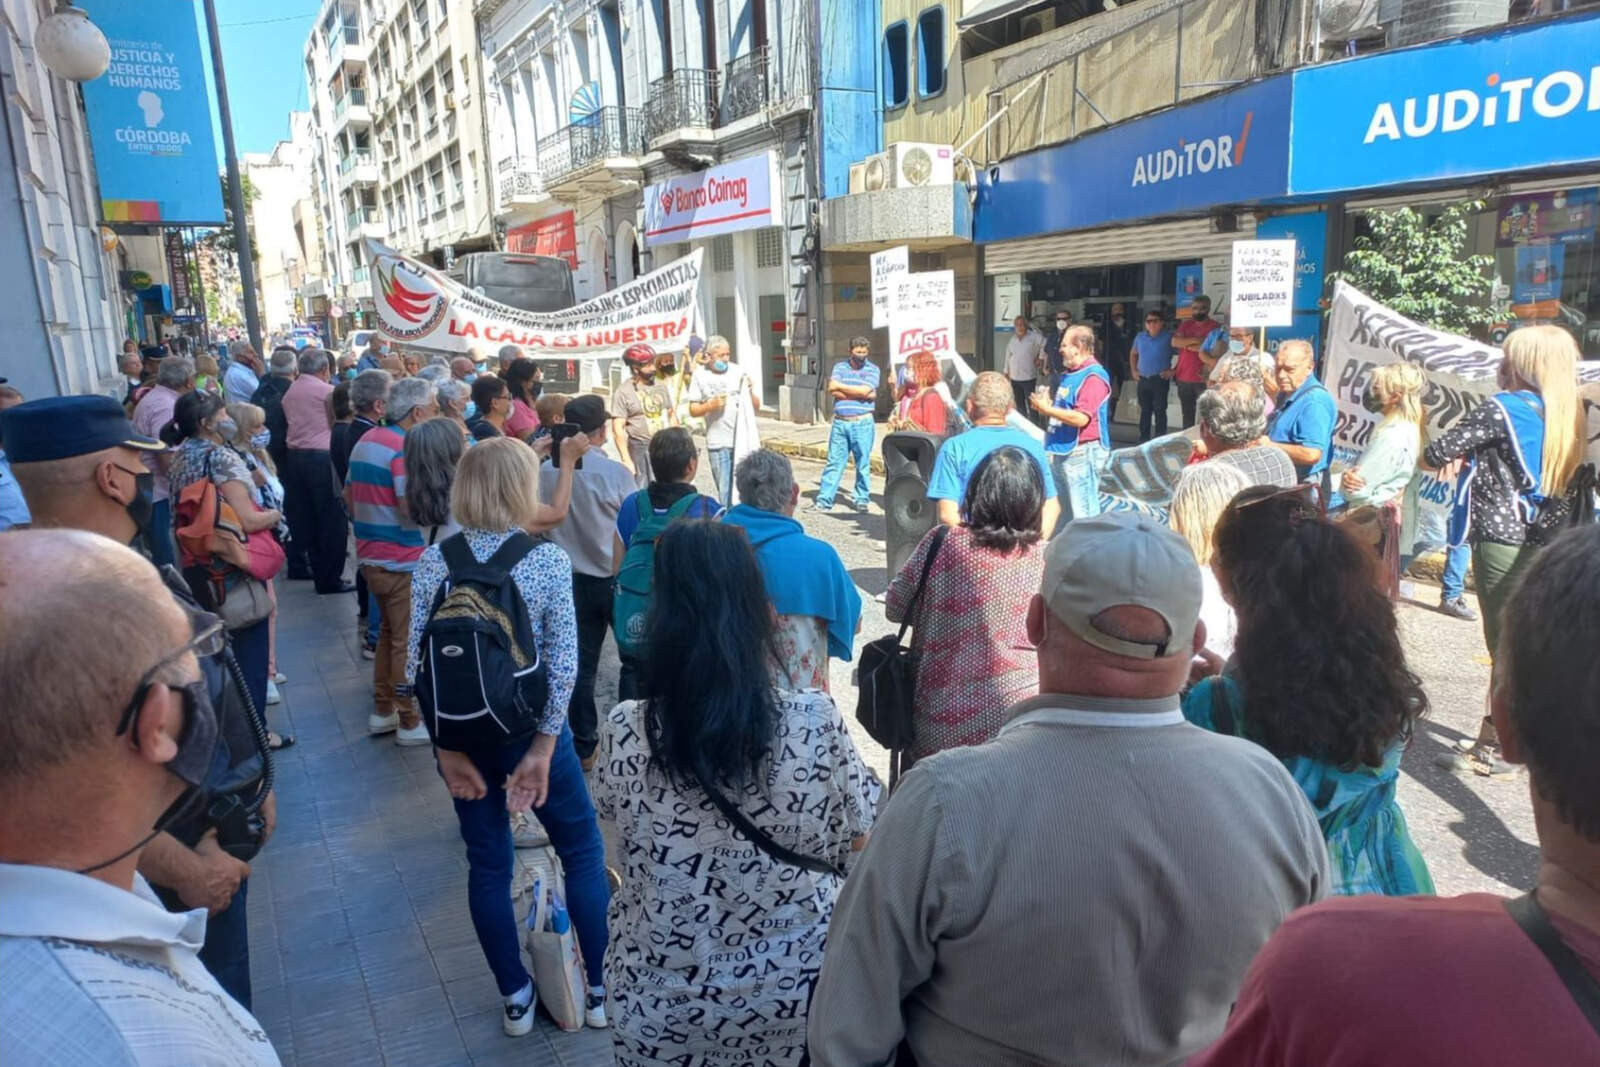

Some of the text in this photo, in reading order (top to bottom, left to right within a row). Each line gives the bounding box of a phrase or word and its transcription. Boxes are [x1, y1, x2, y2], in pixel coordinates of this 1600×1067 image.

[110, 49, 175, 64] USTICIA Y
[107, 63, 180, 78] DERECHOS
[108, 75, 181, 90] HUMANOS
[114, 126, 192, 145] CÓRDOBA
[675, 176, 747, 213] Banco Coinag
[448, 316, 688, 347] LA CAJA ES NUESTRA
[901, 331, 949, 352] MST
